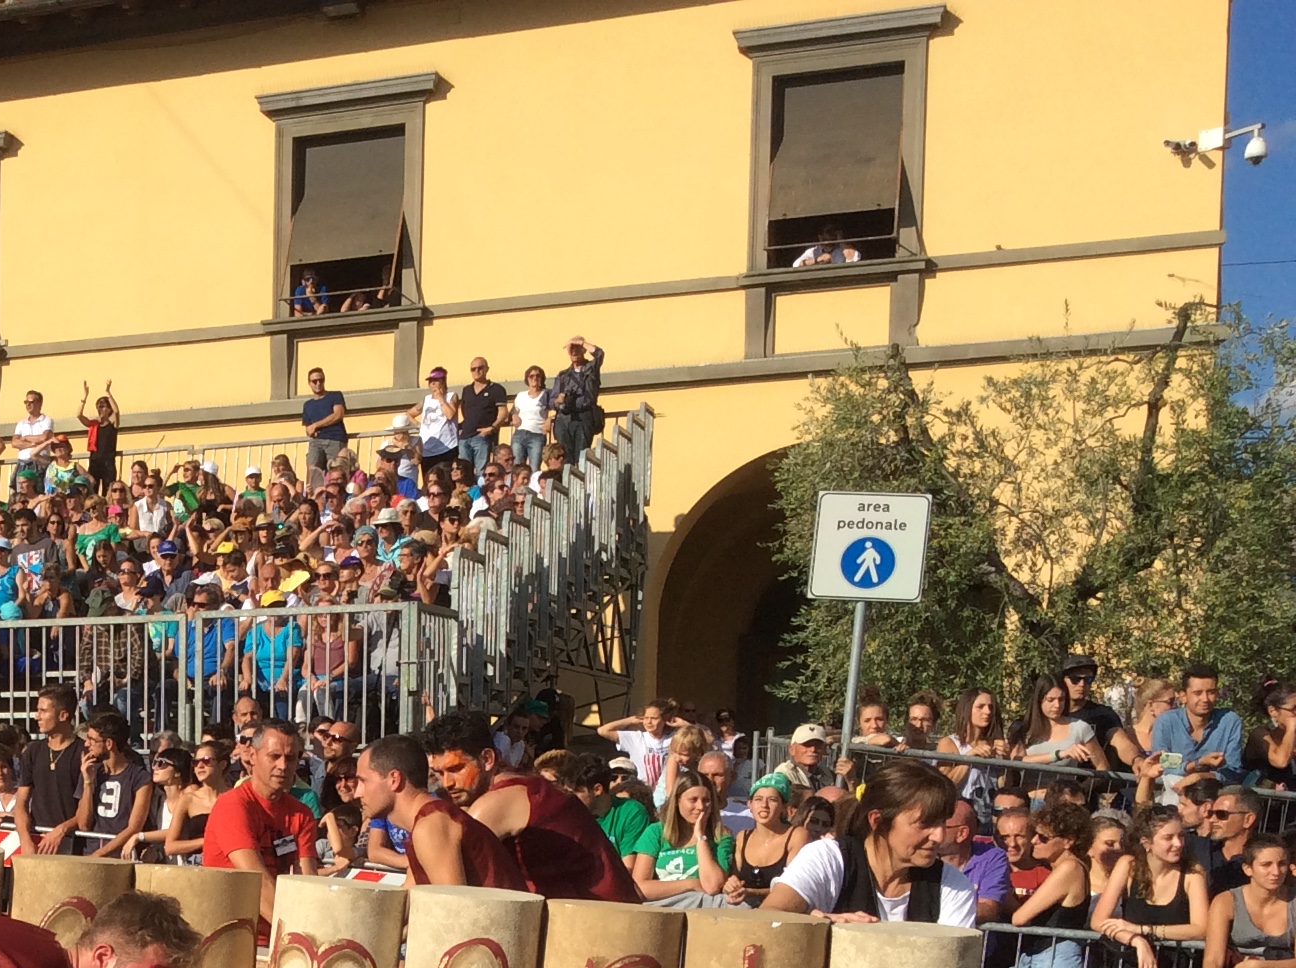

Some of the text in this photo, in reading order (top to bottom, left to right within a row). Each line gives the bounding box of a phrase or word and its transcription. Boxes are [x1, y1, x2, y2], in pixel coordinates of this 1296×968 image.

[857, 502, 890, 513] area
[837, 518, 907, 531] pedonale
[98, 781, 121, 818] 9
